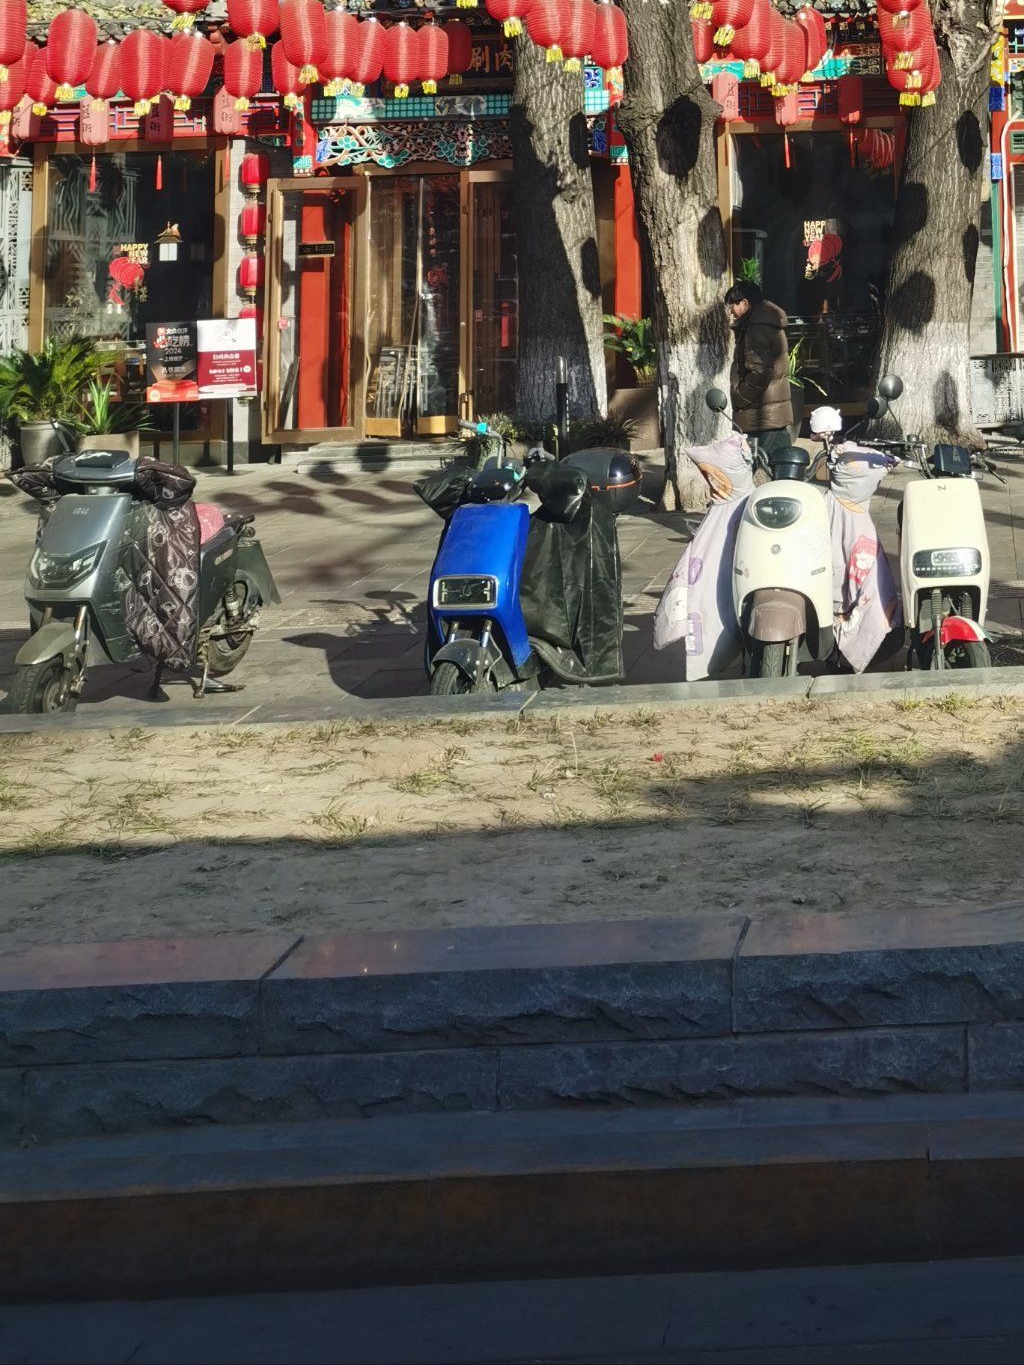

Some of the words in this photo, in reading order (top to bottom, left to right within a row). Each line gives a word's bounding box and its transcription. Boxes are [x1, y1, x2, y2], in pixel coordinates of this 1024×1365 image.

[804, 227, 824, 235] NEW
[120, 243, 149, 251] HAPPY
[128, 250, 149, 258] NEW
[164, 347, 182, 355] 2024
